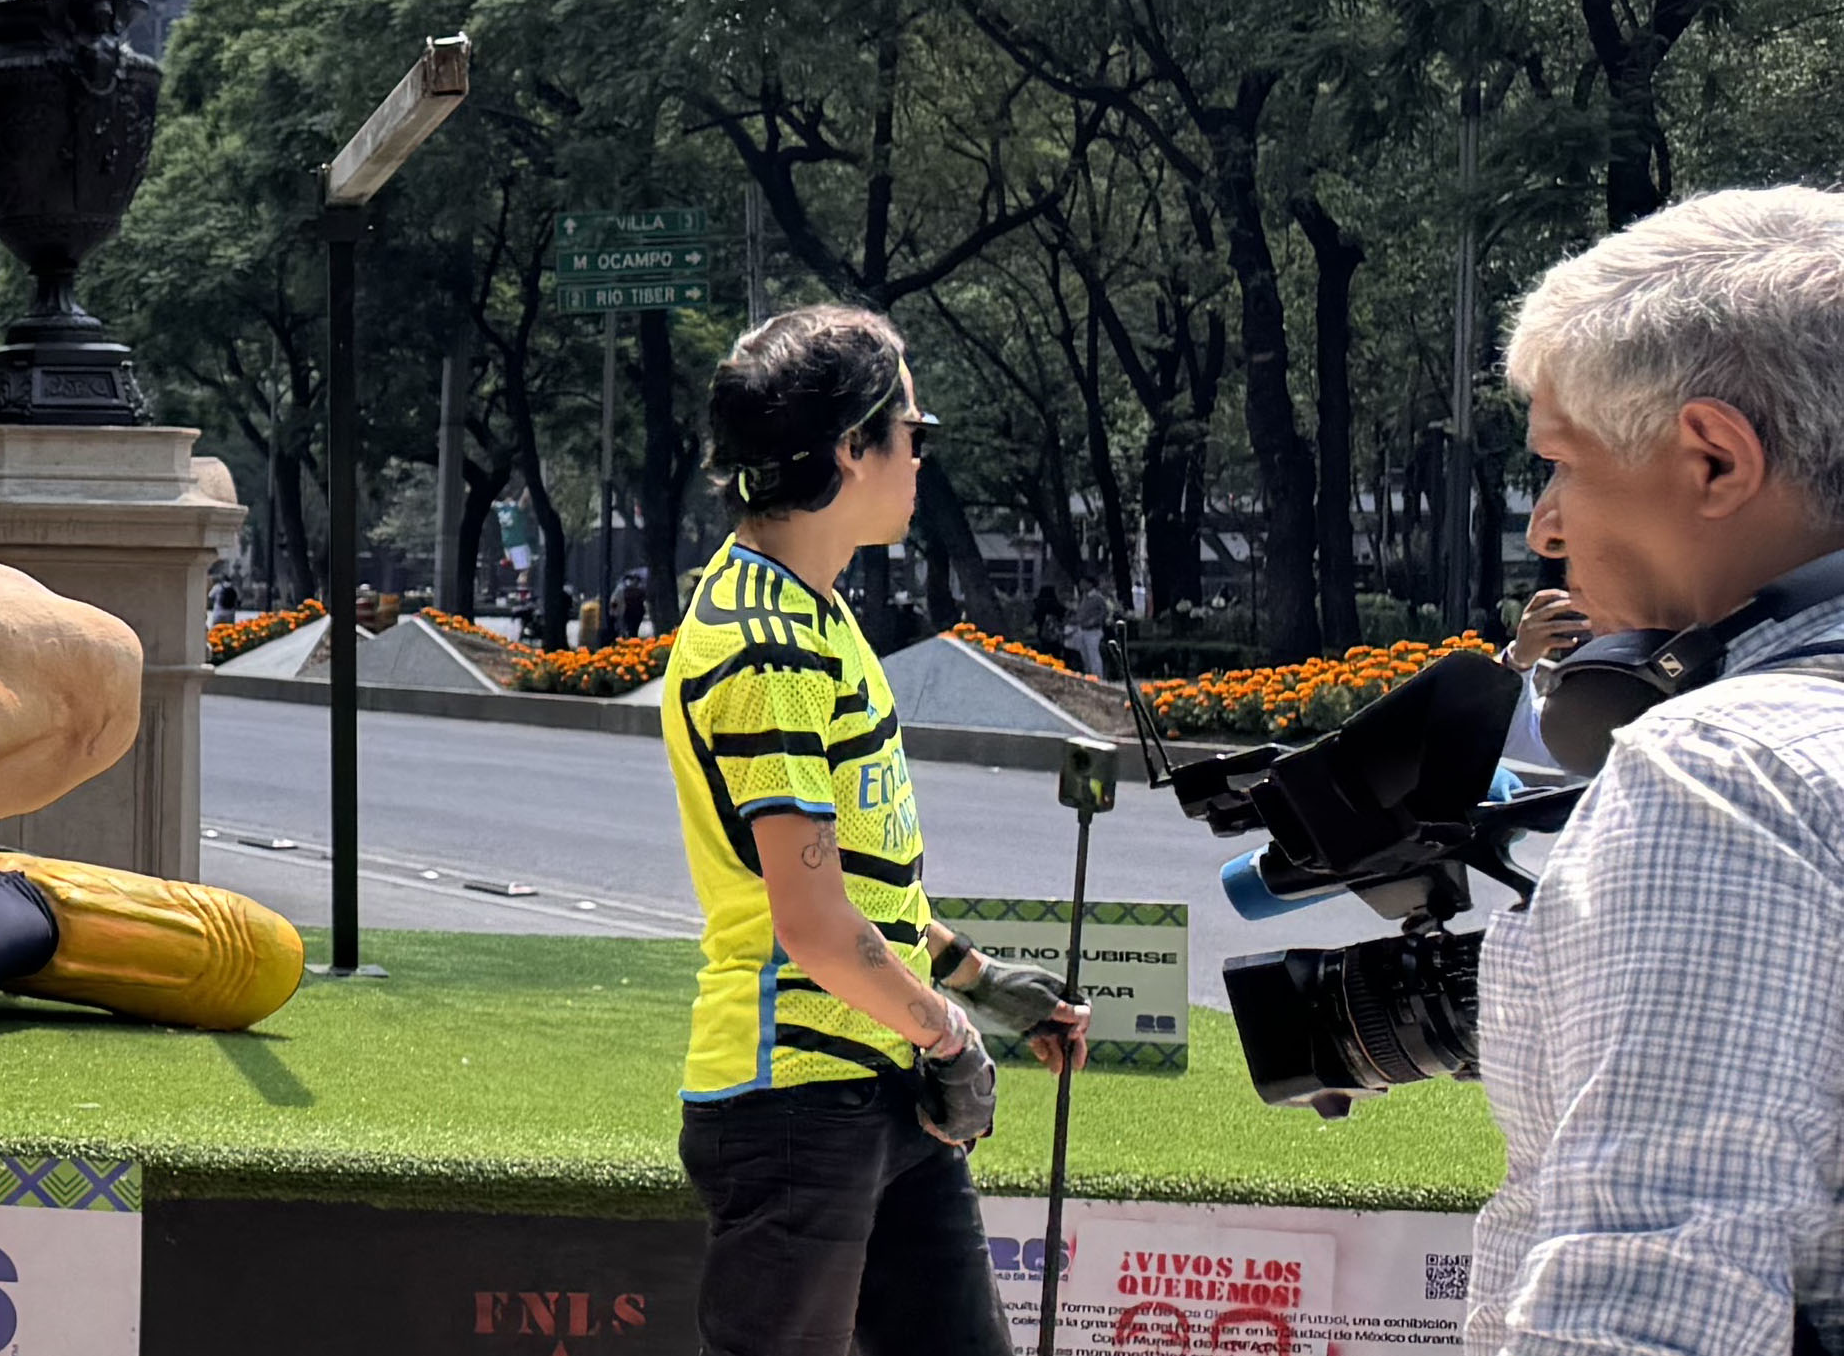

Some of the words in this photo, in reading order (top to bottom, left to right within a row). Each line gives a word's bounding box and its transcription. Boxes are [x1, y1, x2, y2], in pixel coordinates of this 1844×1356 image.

[573, 255, 587, 270] M
[597, 251, 673, 270] OCAMPO
[1021, 947, 1060, 960] NO
[1065, 948, 1178, 964] UBIRSE
[1120, 1251, 1233, 1278] ¡VIVOS
[1245, 1258, 1302, 1283] LOS
[1117, 1274, 1302, 1308] QUEREMOS!
[473, 1290, 647, 1337] FNLS
